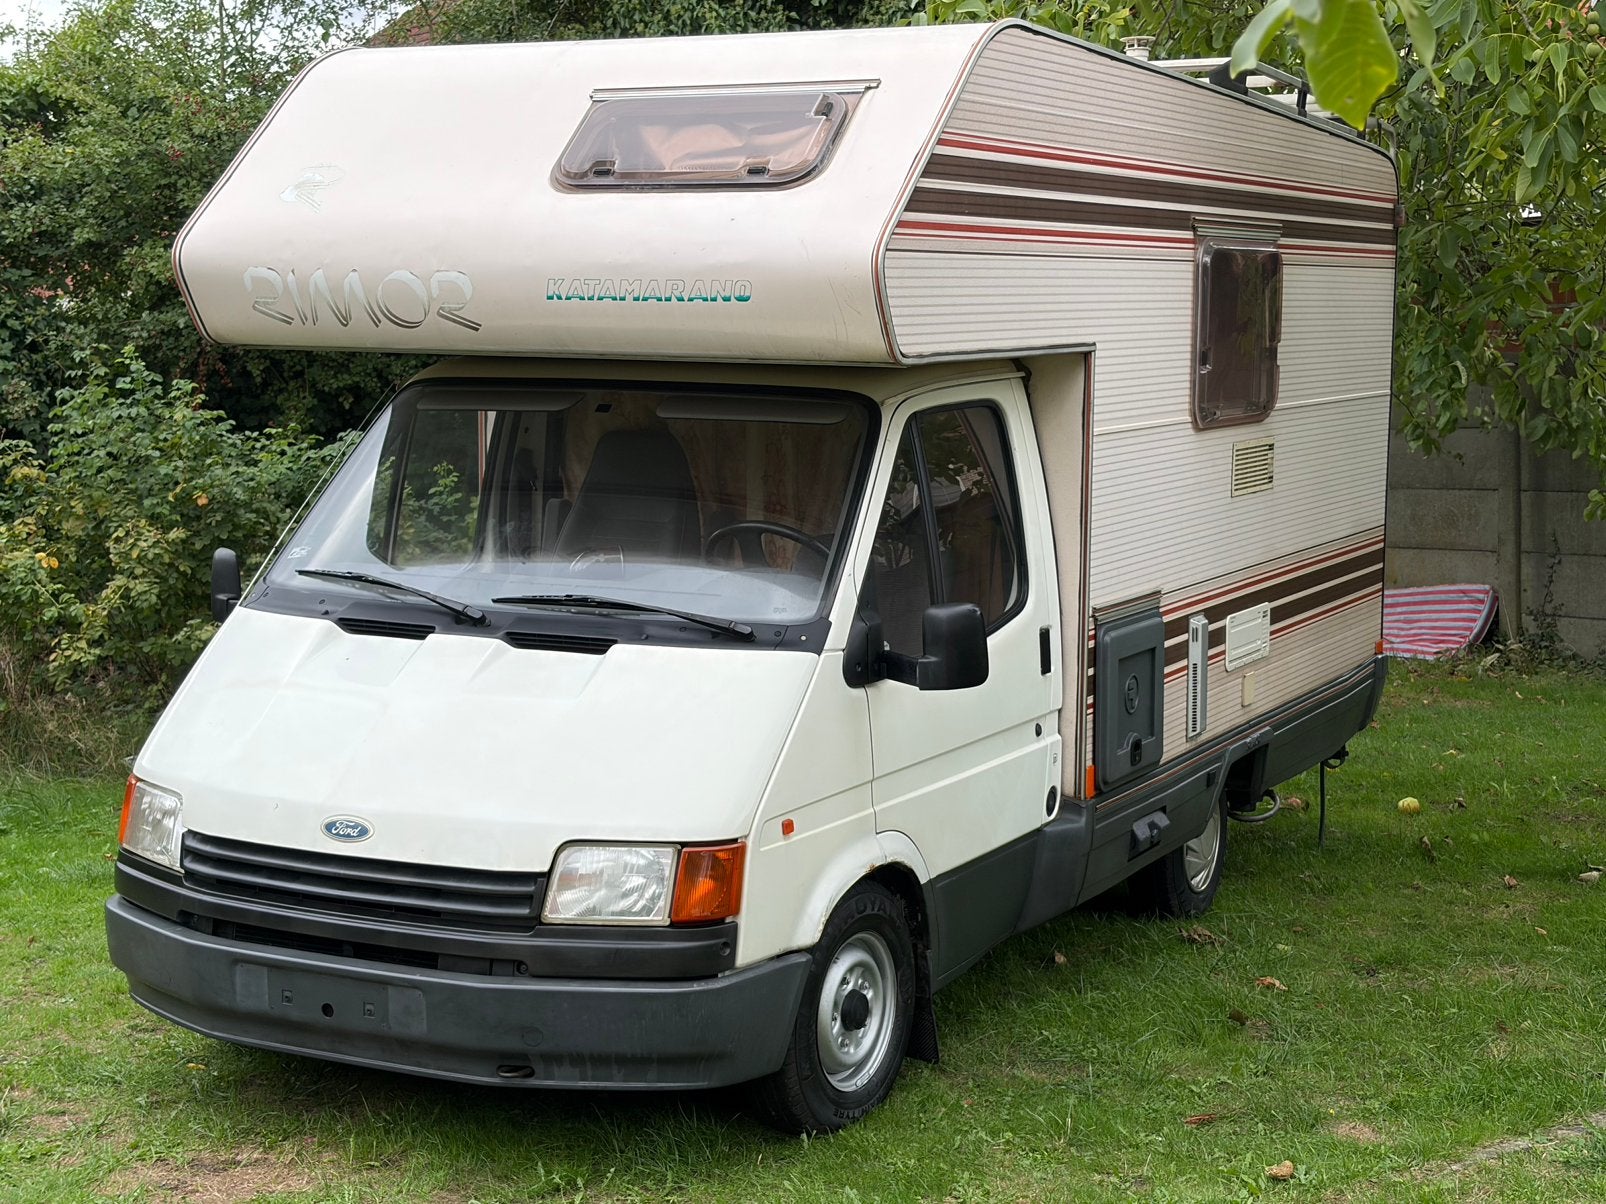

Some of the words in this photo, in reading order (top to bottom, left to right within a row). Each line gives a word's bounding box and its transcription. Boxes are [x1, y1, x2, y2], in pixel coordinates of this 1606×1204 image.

[242, 266, 482, 333] RIMOR
[545, 277, 753, 303] KATAMARANO
[331, 820, 361, 836] Ford
